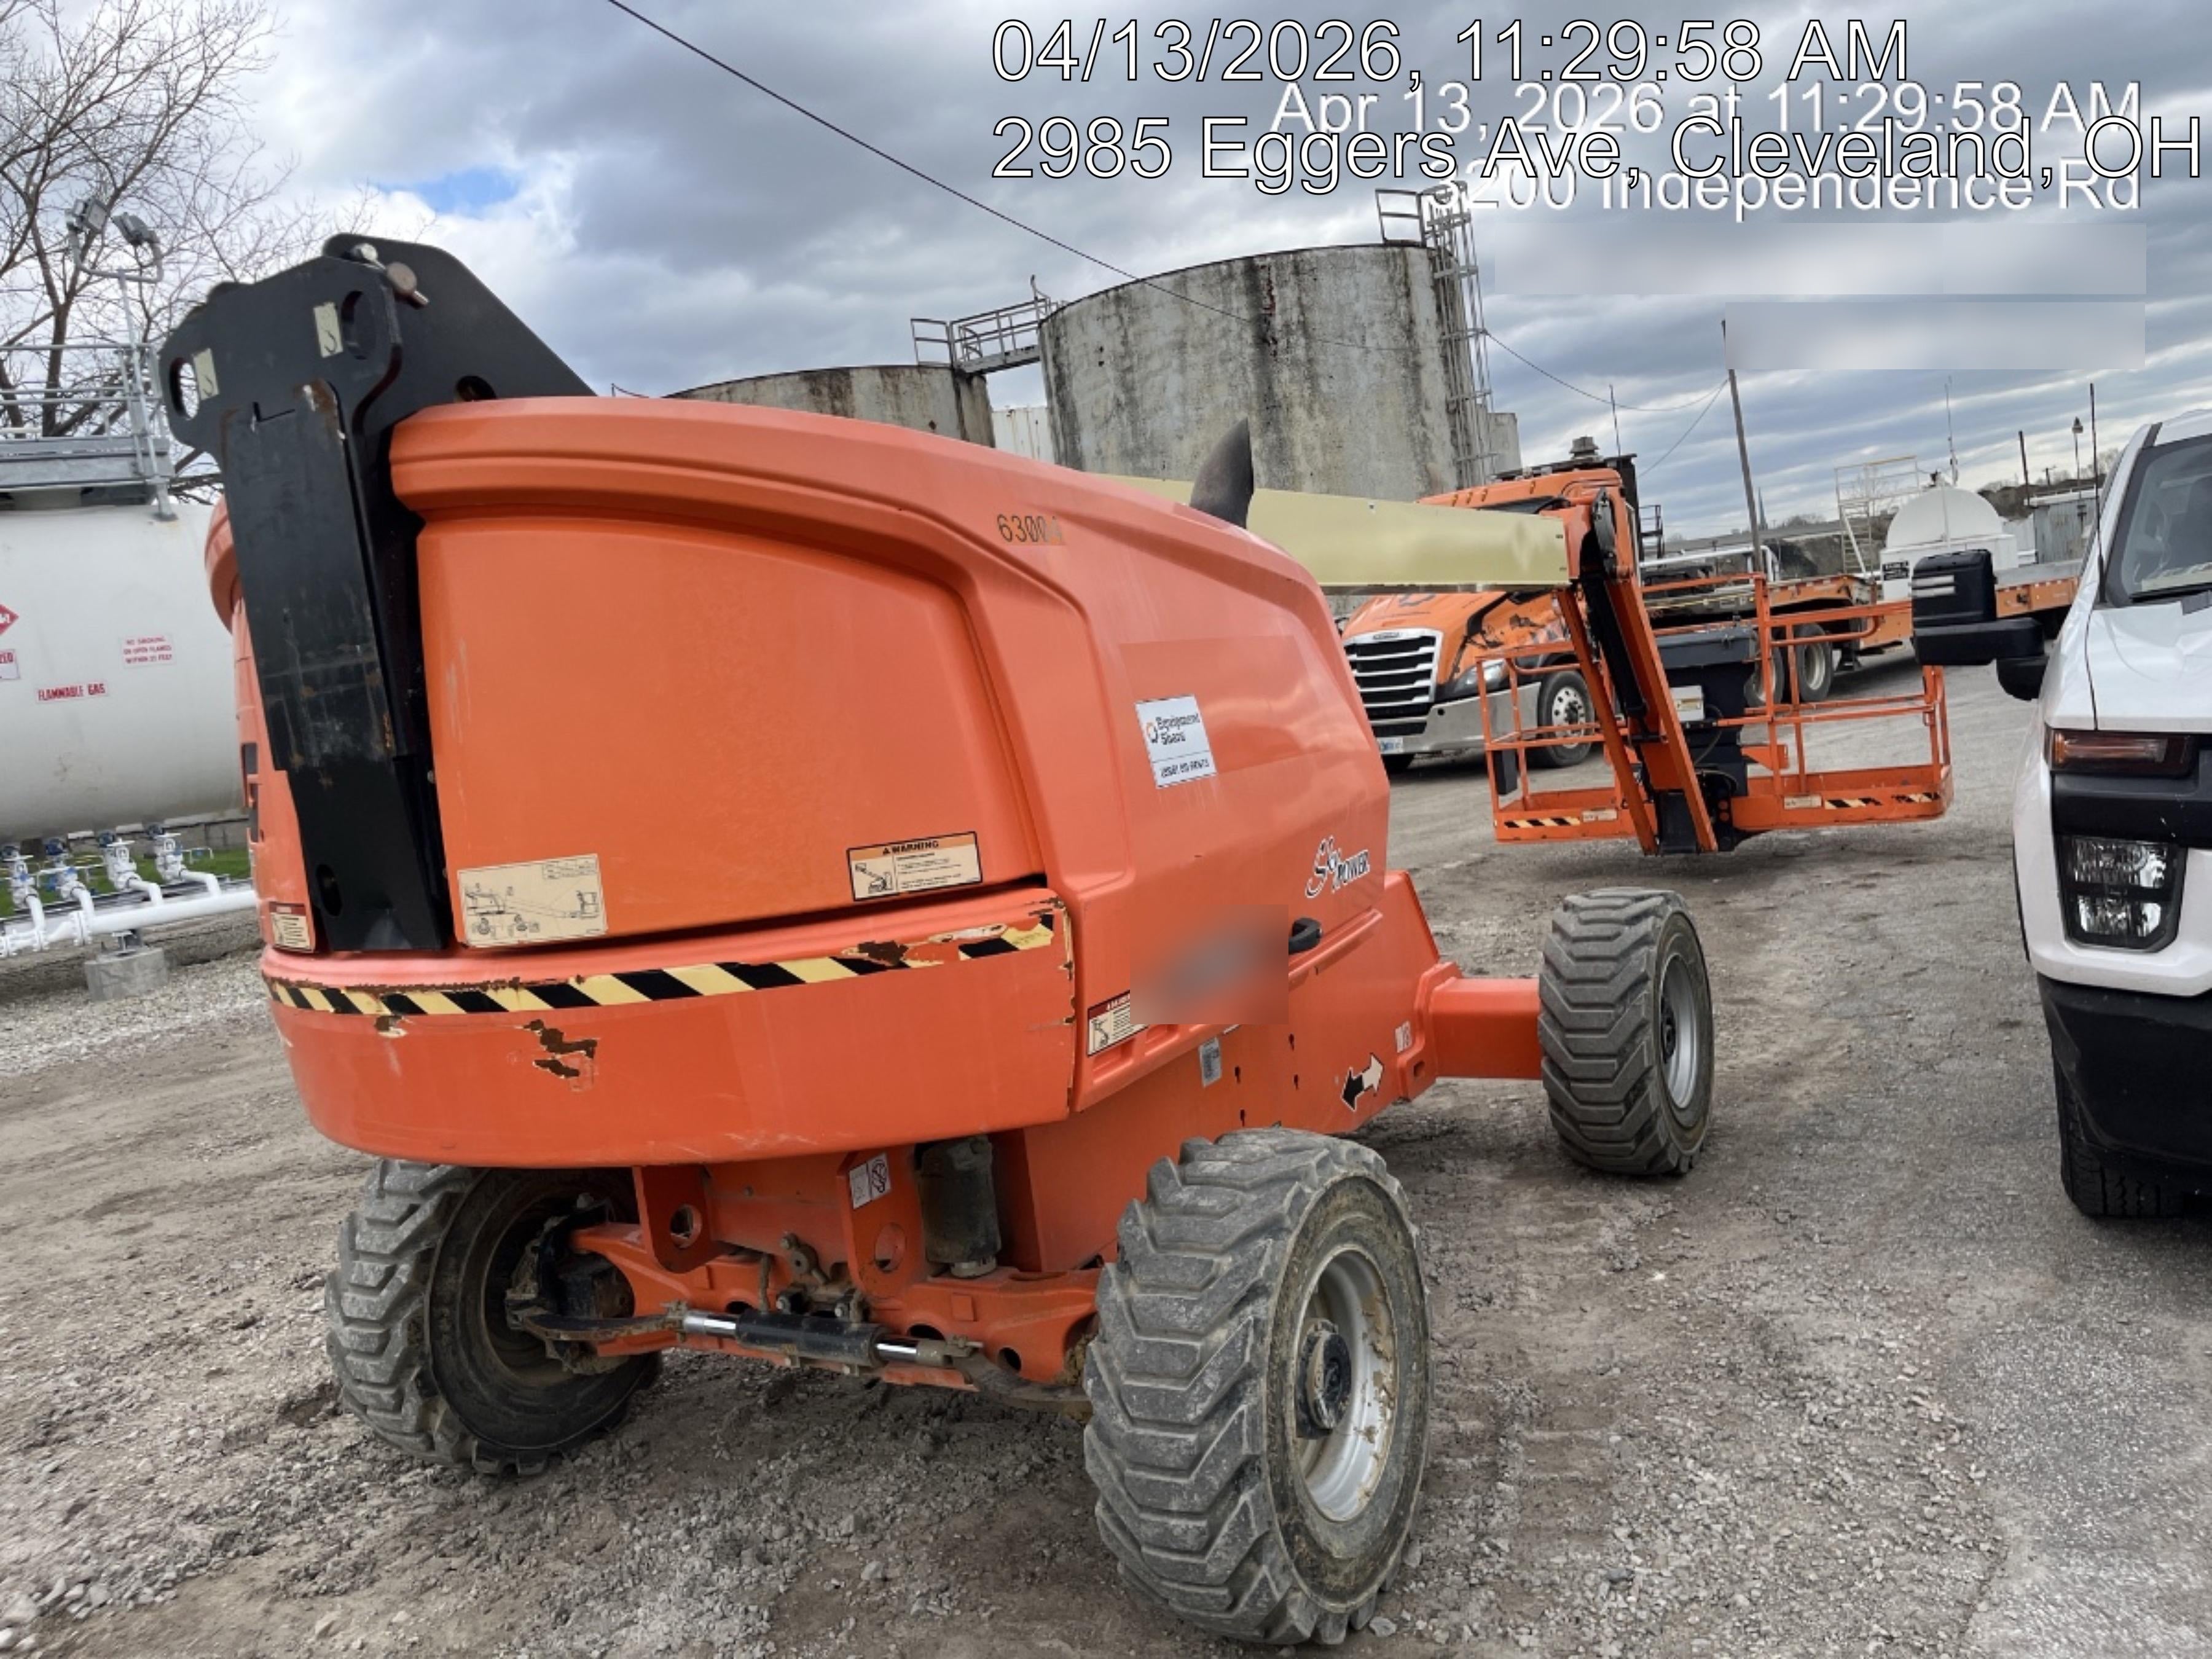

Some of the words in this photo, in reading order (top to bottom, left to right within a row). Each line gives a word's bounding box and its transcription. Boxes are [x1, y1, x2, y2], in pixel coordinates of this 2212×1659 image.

[38, 684, 84, 701] FLAMMABLE
[87, 683, 106, 696] GAS
[892, 840, 939, 853] WARNING
